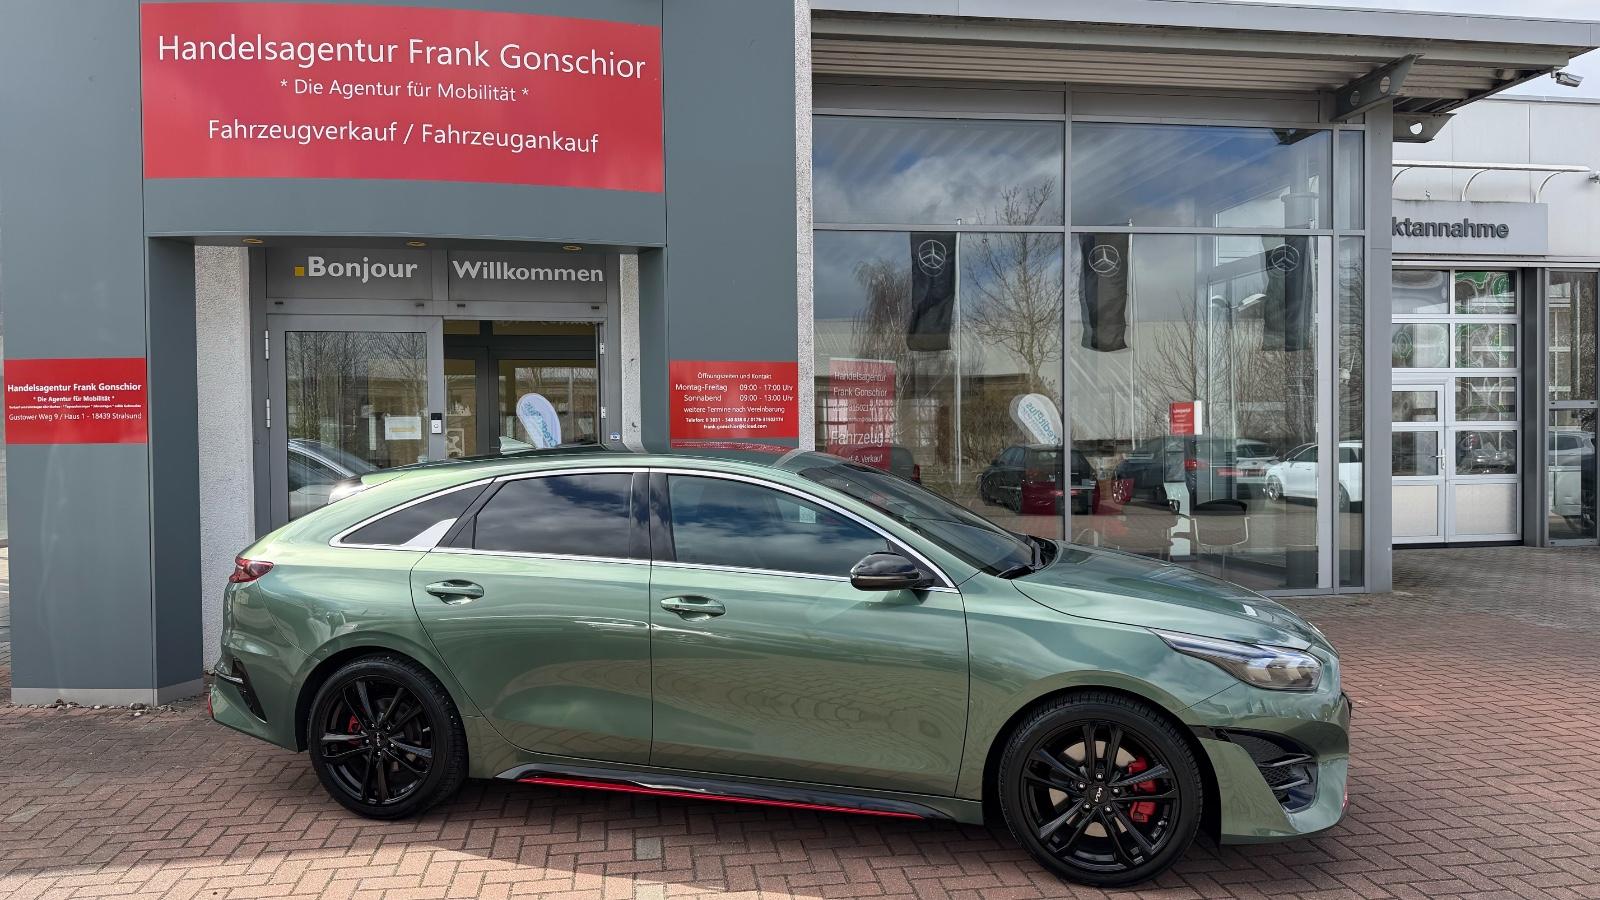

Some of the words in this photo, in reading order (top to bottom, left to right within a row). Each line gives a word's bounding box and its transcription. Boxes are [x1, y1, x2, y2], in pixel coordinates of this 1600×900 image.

[159, 34, 398, 69] Handelsagentur
[409, 39, 490, 67] Frank
[500, 43, 646, 79] Gonschior
[295, 79, 324, 95] Die
[329, 79, 401, 99] Agentur
[407, 81, 431, 97] für
[438, 83, 516, 101] Mobilität
[209, 119, 398, 145] Fahrzeugverkauf
[403, 124, 414, 144] /
[422, 124, 599, 153] Fahrzeugankauf
[308, 256, 418, 283] Bonjour
[452, 260, 604, 282] Willkommen
[834, 371, 887, 383] Handelsagentur
[7, 384, 71, 393] Handelsagentur
[73, 383, 97, 392] Frank
[98, 382, 142, 392] Gonschior
[675, 384, 728, 392] Montag-Freitag
[833, 387, 853, 396] Frank
[854, 387, 888, 397] Gonschior
[48, 396, 71, 404] Agentur
[38, 414, 53, 422] Weg
[830, 430, 884, 447] Fahrzeug
